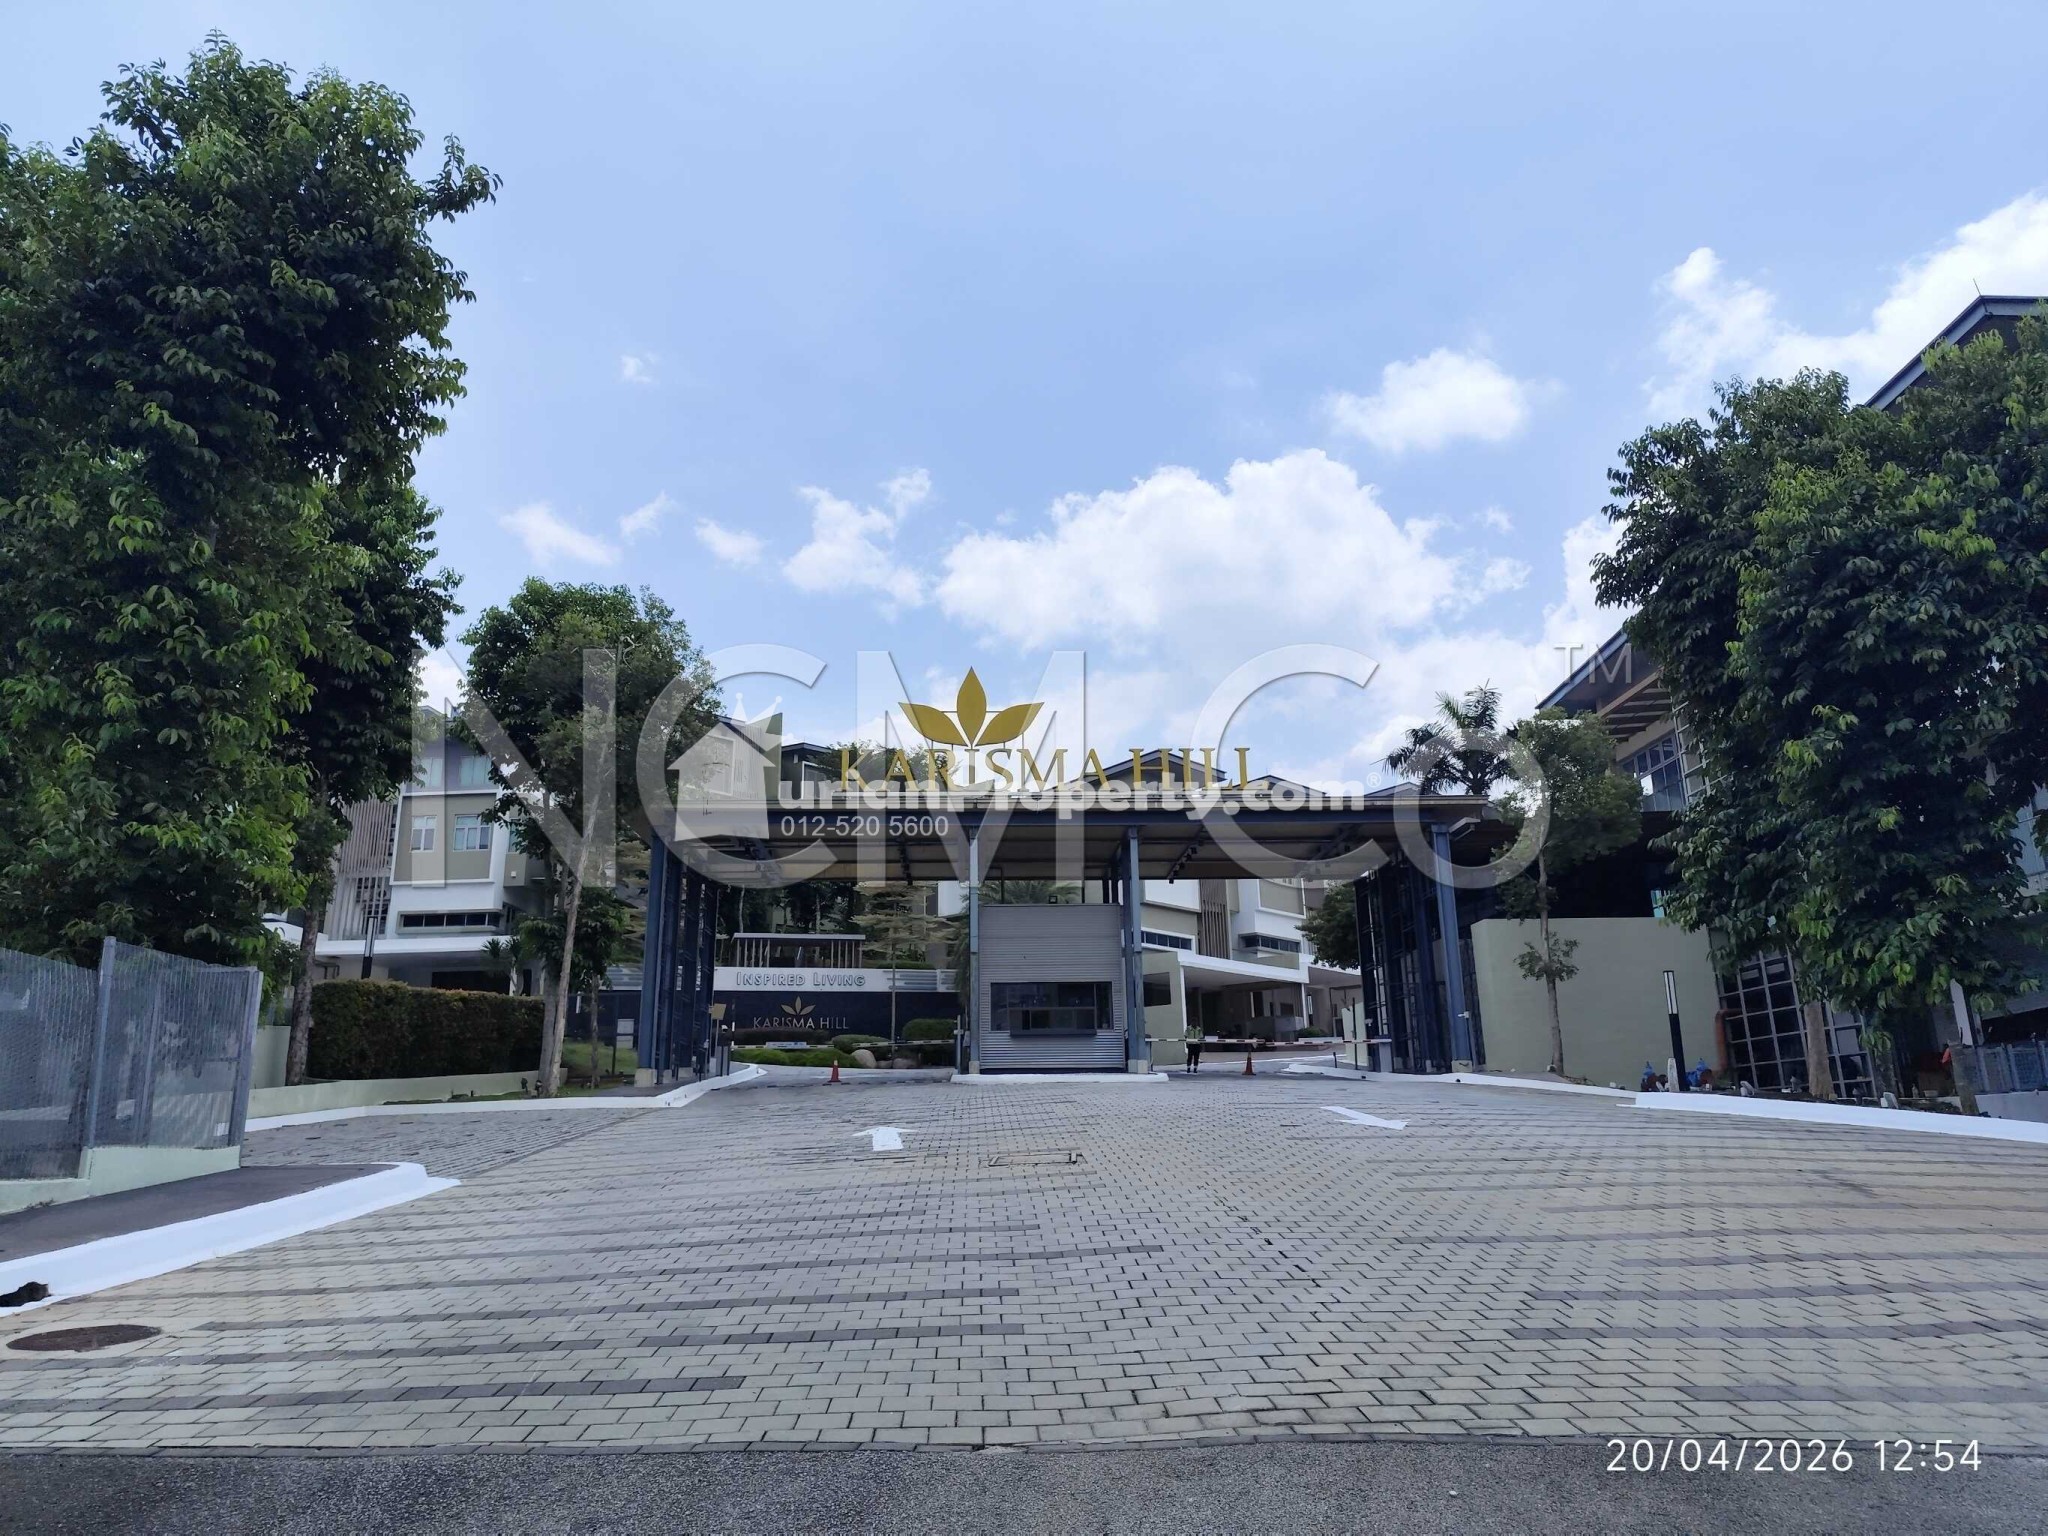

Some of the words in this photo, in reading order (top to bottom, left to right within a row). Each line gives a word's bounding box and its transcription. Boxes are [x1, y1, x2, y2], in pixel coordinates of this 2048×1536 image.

[838, 748, 1115, 793] KARISMA
[1128, 747, 1269, 790] HILL
[752, 1016, 816, 1030] KARISMA
[820, 1016, 849, 1030] HILL
